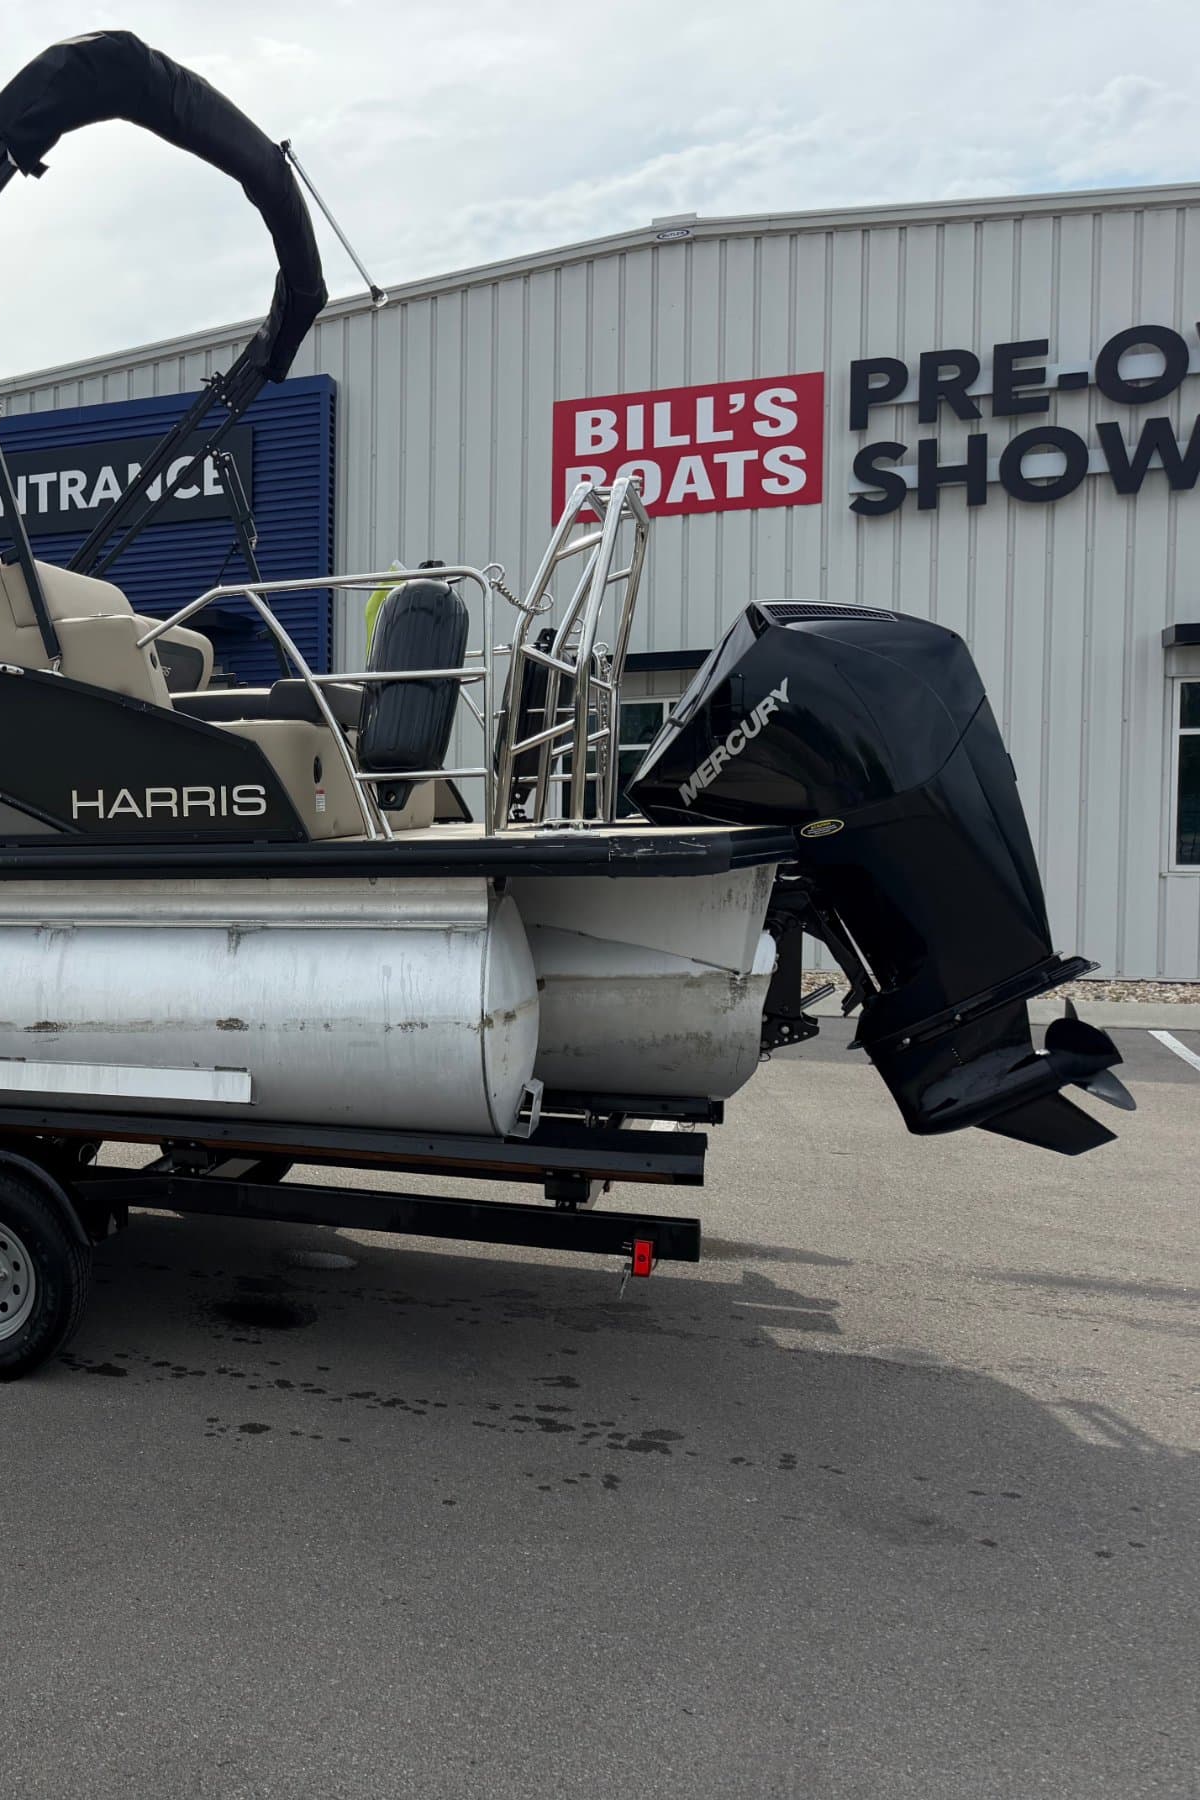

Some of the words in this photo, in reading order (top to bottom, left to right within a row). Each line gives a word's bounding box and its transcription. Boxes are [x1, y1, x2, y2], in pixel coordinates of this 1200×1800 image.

[849, 322, 1200, 431] PRE-O
[575, 387, 799, 456] BILL'S
[564, 445, 807, 511] BOATS
[849, 414, 1200, 516] SHOW
[678, 677, 790, 807] MERCURY
[71, 784, 268, 820] HARRIS
